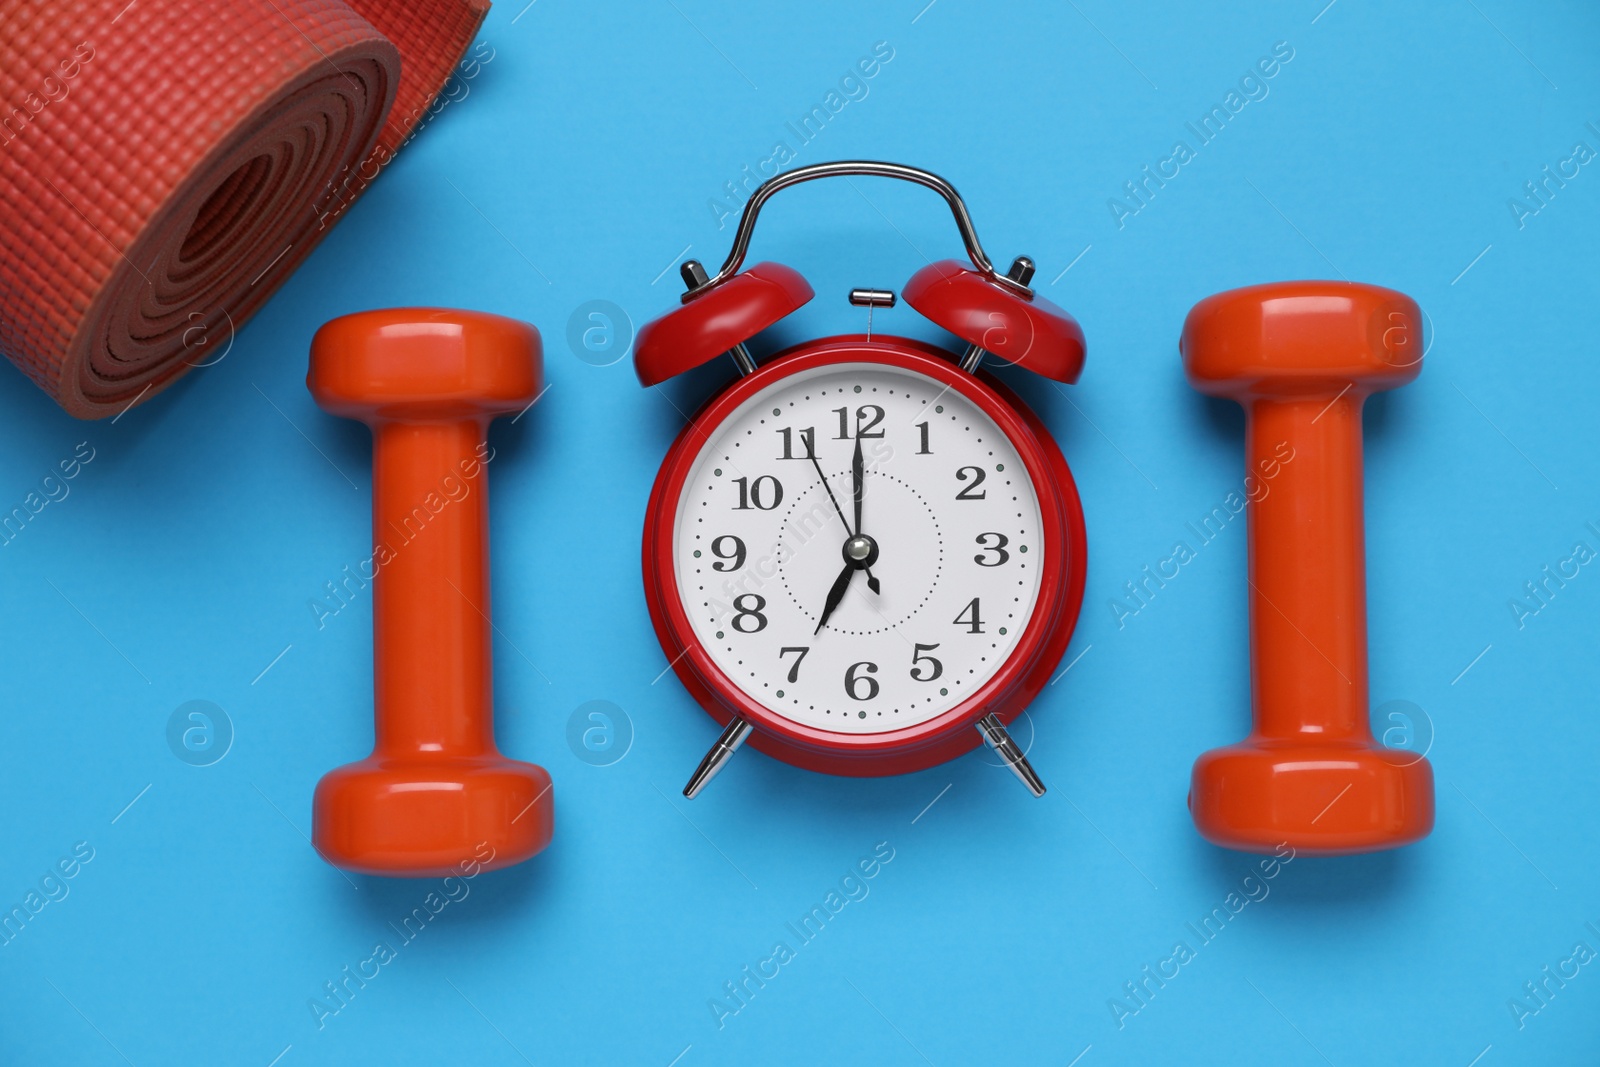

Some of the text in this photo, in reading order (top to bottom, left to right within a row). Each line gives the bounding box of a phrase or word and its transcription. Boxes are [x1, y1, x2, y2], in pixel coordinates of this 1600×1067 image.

[831, 404, 886, 440] 12
[915, 421, 935, 455] 1
[775, 426, 822, 460] 11
[731, 475, 784, 511] 10
[955, 466, 986, 501] 2
[711, 535, 747, 573] 9
[973, 532, 1010, 567] 3
[731, 593, 768, 634] 8
[952, 597, 986, 634] 4
[779, 646, 810, 684] 7
[910, 643, 943, 682] 5
[844, 661, 880, 701] 6
